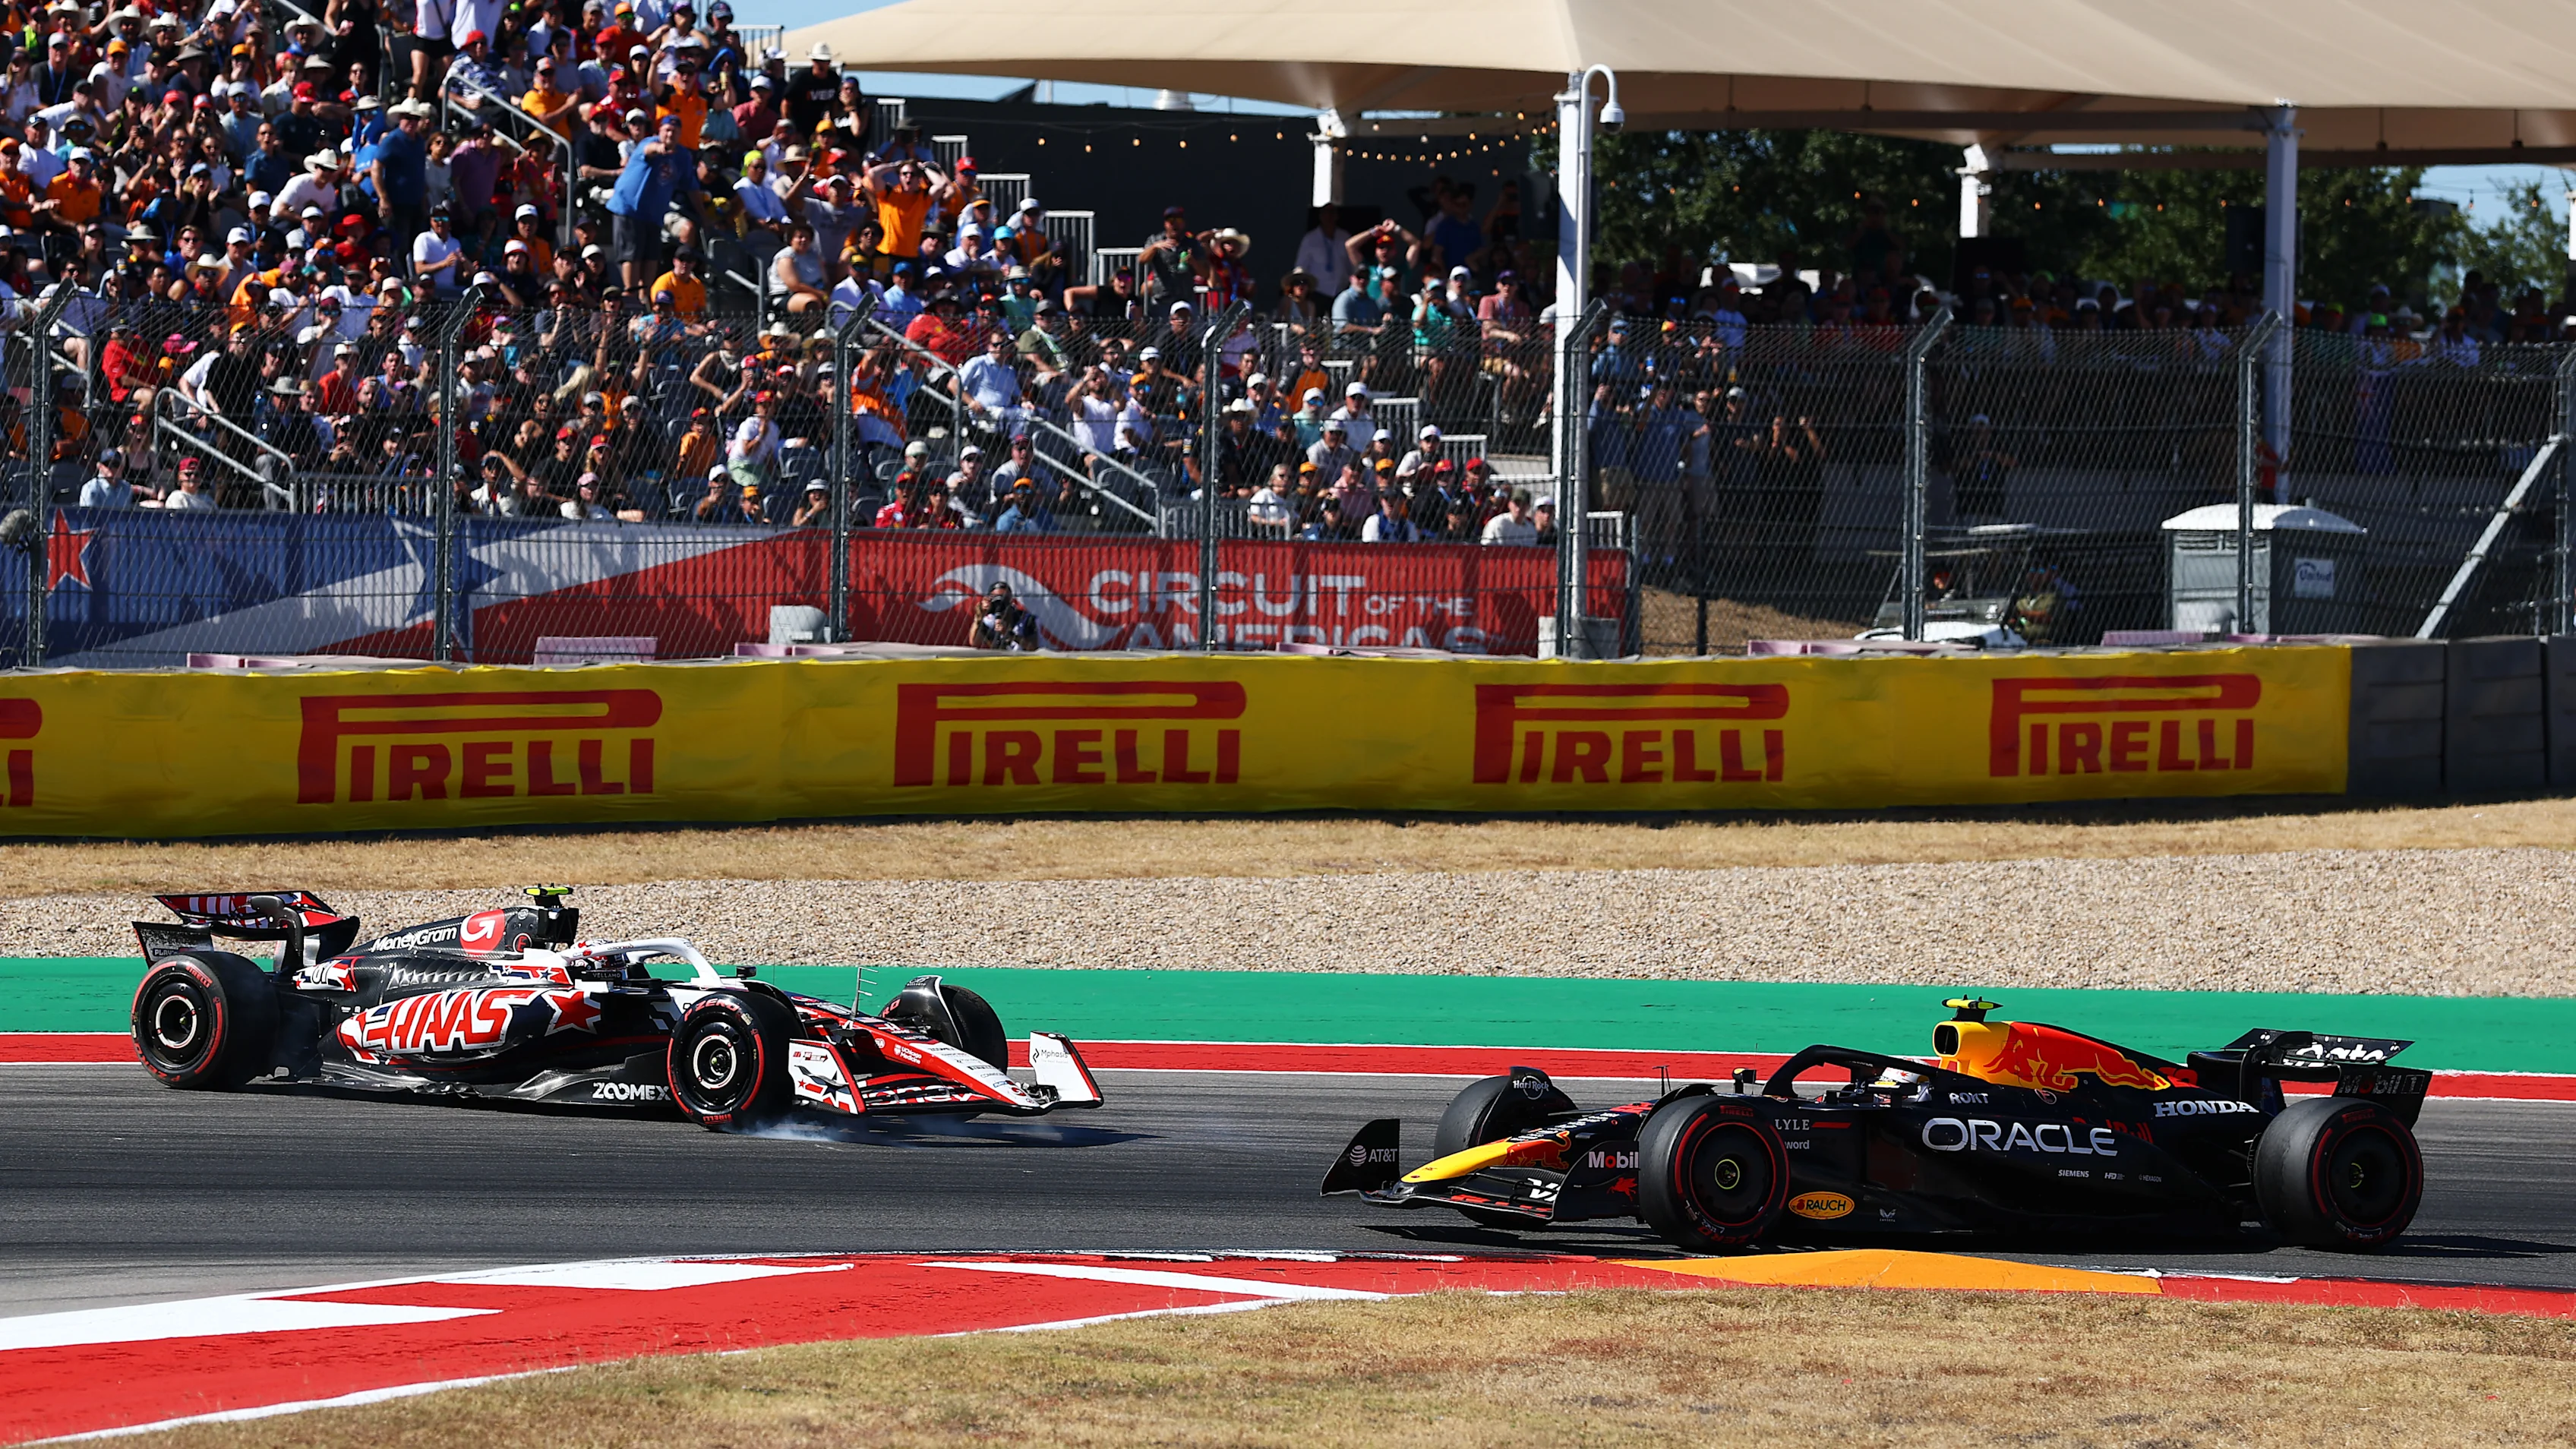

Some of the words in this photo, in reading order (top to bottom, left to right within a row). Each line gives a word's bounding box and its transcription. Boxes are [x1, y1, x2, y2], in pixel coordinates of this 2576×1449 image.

[1090, 570, 1365, 616] CIRCUIT
[1364, 595, 1404, 616] OF
[1413, 596, 1474, 617] THE
[894, 681, 1246, 787] PIRELLI
[1473, 683, 1789, 784] PIRELLI
[1990, 674, 2262, 777] PIRELLI
[297, 689, 662, 803] PIRELLI
[369, 926, 457, 952] MoneyGram
[185, 963, 213, 988] PIRELLI
[696, 998, 739, 1012] ZERO
[367, 990, 537, 1051] HAAS
[1041, 1050, 1069, 1059] Mphasis
[592, 1082, 671, 1100] ZOOMEX
[1532, 1081, 1549, 1091] Rock
[2338, 1073, 2401, 1094] Mobil
[1949, 1092, 1988, 1104] ROKT
[1719, 1106, 1754, 1116] PIRELLI
[2154, 1100, 2260, 1117] HONDA
[702, 1113, 733, 1124] PIRELLI
[1775, 1119, 1810, 1130] LYLE
[1785, 1139, 1810, 1150] word
[1922, 1118, 2118, 1156] ORACLE
[1368, 1148, 1397, 1162] AT&T
[1588, 1151, 1639, 1168] Mobil
[2058, 1169, 2089, 1178] SIEMENS
[2142, 1174, 2162, 1182] HEXAGON
[1806, 1199, 1847, 1211] RAUCH
